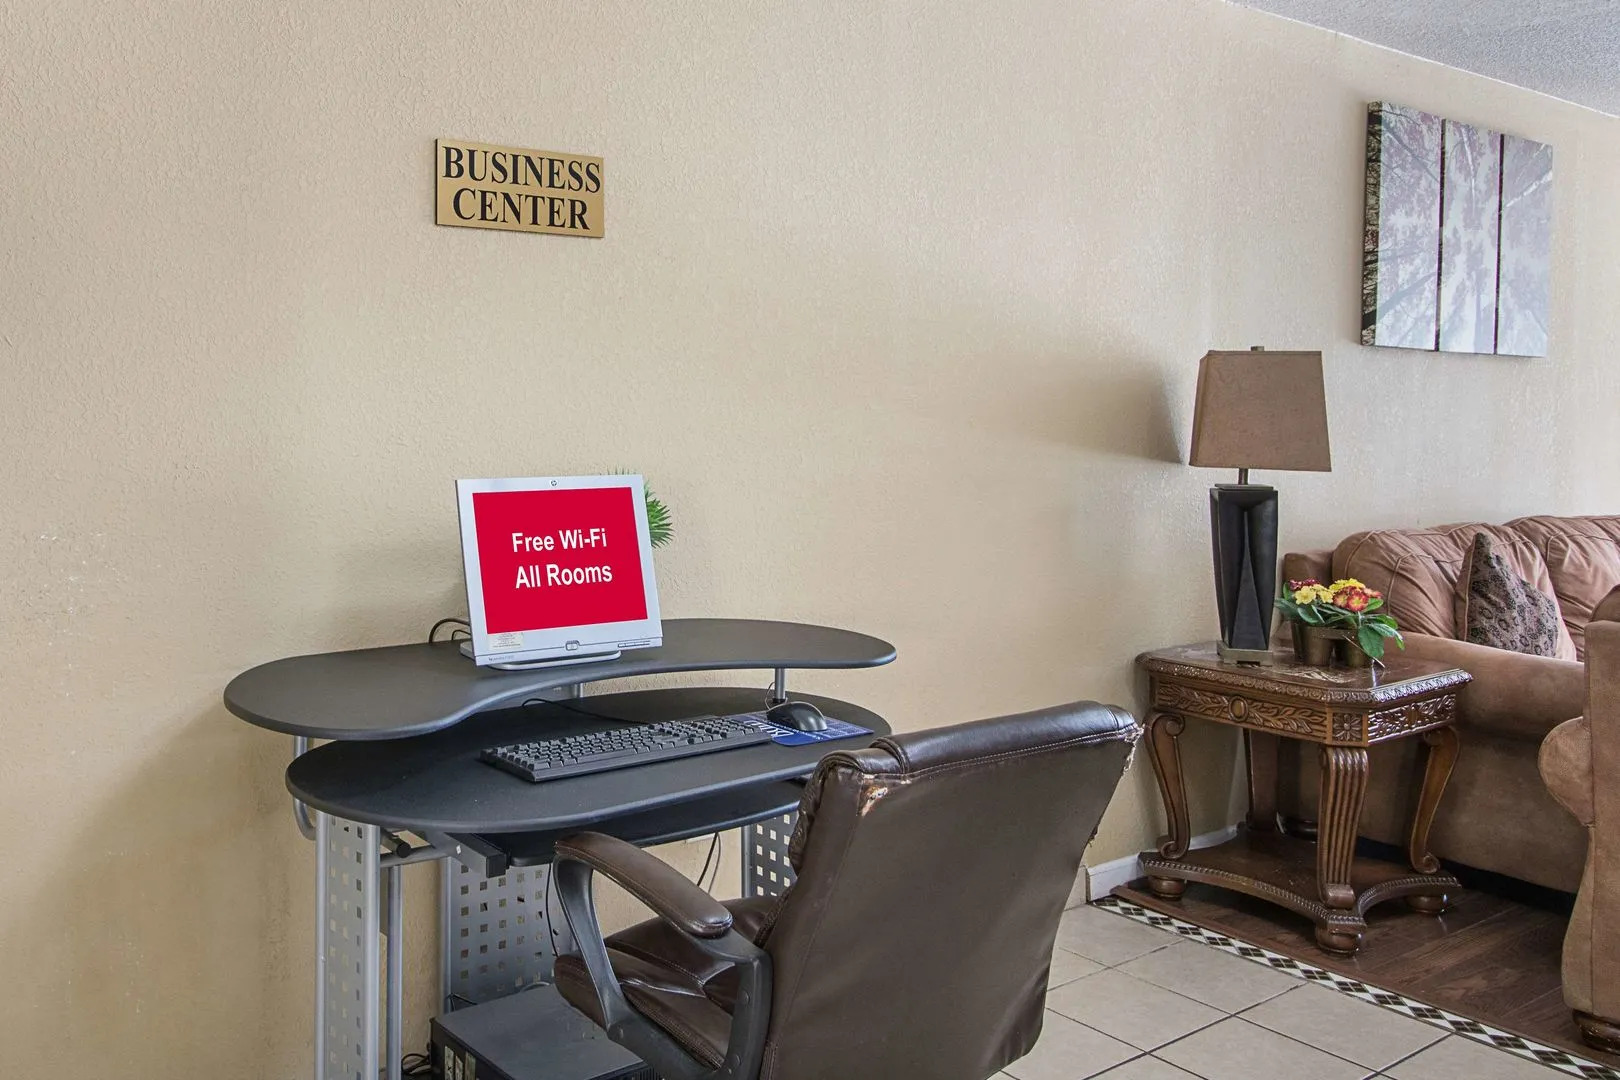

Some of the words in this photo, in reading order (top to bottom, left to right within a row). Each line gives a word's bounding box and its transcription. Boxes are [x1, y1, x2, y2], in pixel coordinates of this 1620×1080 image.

[442, 146, 600, 193] BUSINESS
[453, 188, 590, 230] CENTER
[511, 532, 555, 553] Free
[559, 528, 608, 550] Wi-Fi
[515, 565, 542, 589] All
[546, 563, 613, 587] Rooms
